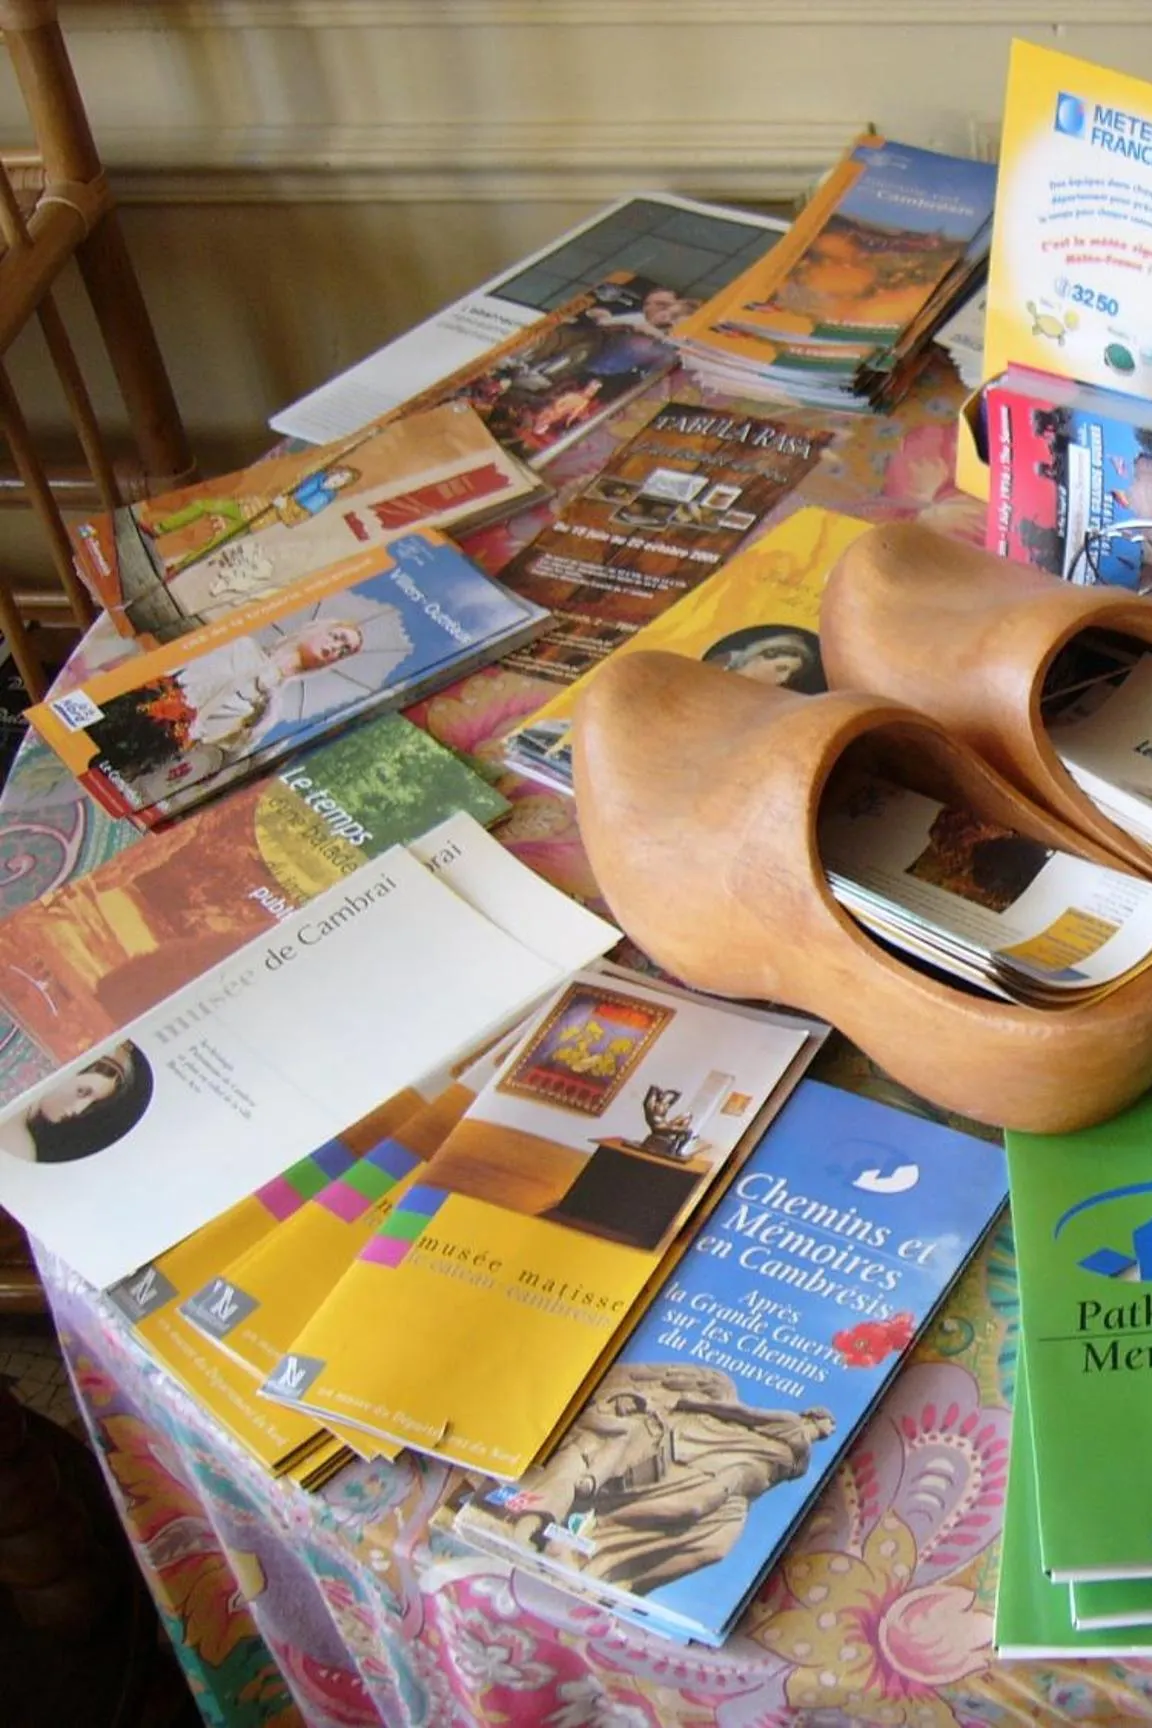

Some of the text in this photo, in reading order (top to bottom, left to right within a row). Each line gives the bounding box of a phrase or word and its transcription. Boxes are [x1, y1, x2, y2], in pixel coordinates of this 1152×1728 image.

[279, 765, 375, 847] Le temps
[155, 871, 399, 1044] musée de Cambrai
[722, 1204, 904, 1292] Mémoires
[735, 1171, 938, 1267] Chemins et
[417, 1232, 628, 1314] musée matisse
[696, 1236, 896, 1321] en Cambrésis
[737, 1290, 803, 1325] Après
[656, 1329, 808, 1399] du Renouveau
[661, 1306, 830, 1384] sur les Chemins
[664, 1281, 853, 1372] la Grande Guerre,
